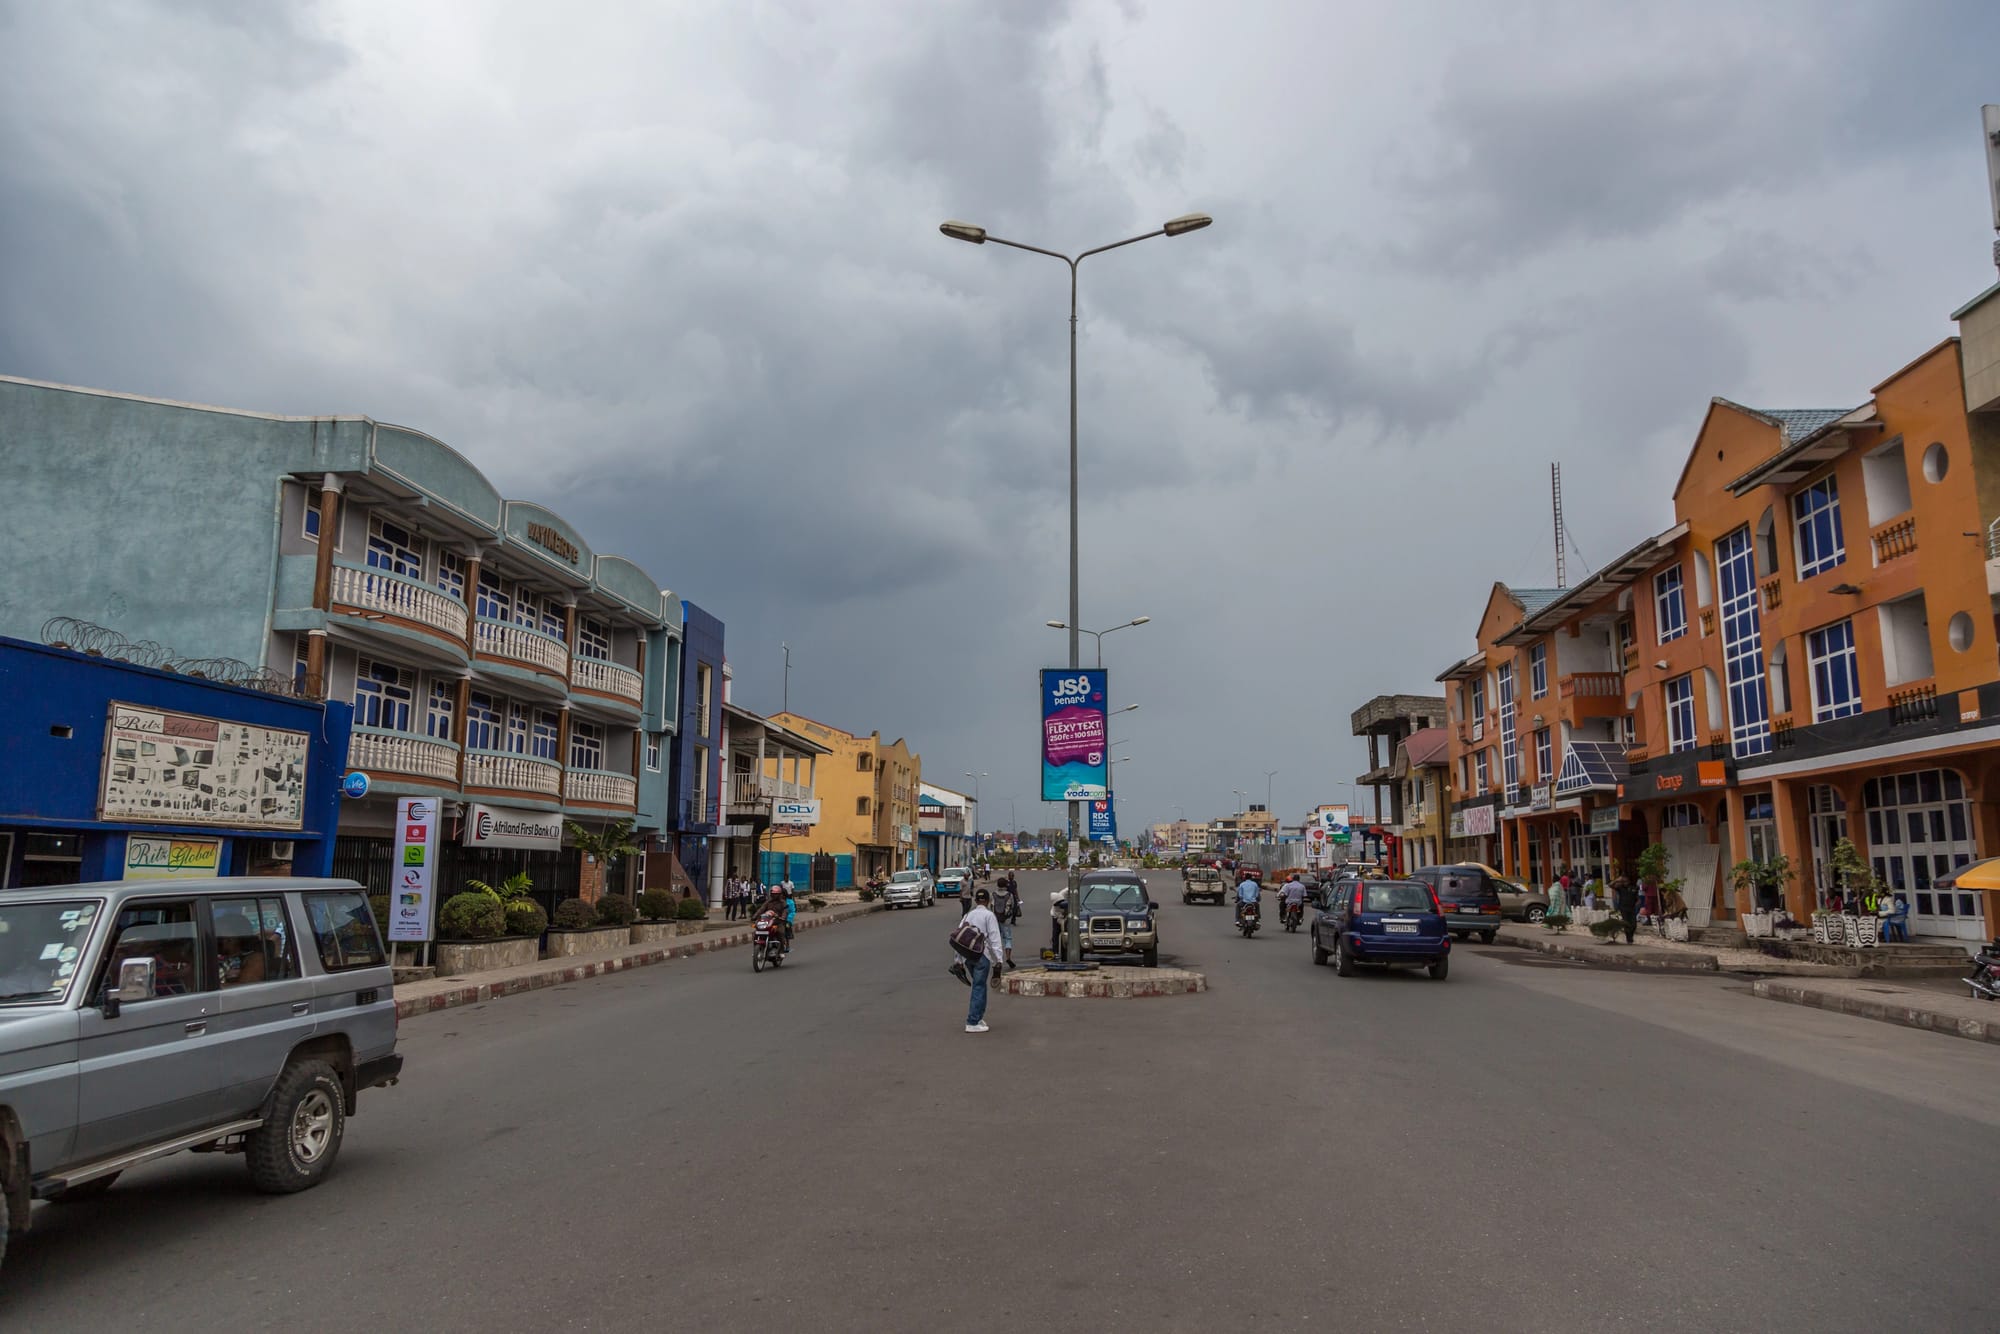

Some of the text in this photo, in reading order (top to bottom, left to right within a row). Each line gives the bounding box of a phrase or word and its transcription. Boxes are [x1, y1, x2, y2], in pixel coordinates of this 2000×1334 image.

[115, 715, 216, 737] Ritz Global
[1048, 720, 1101, 735] FLEXY TEXT
[1067, 789, 1106, 799] vodacom
[1092, 812, 1110, 820] RDC
[493, 820, 560, 838] Afriland First Bank CD
[129, 842, 217, 873] Ritz Global
